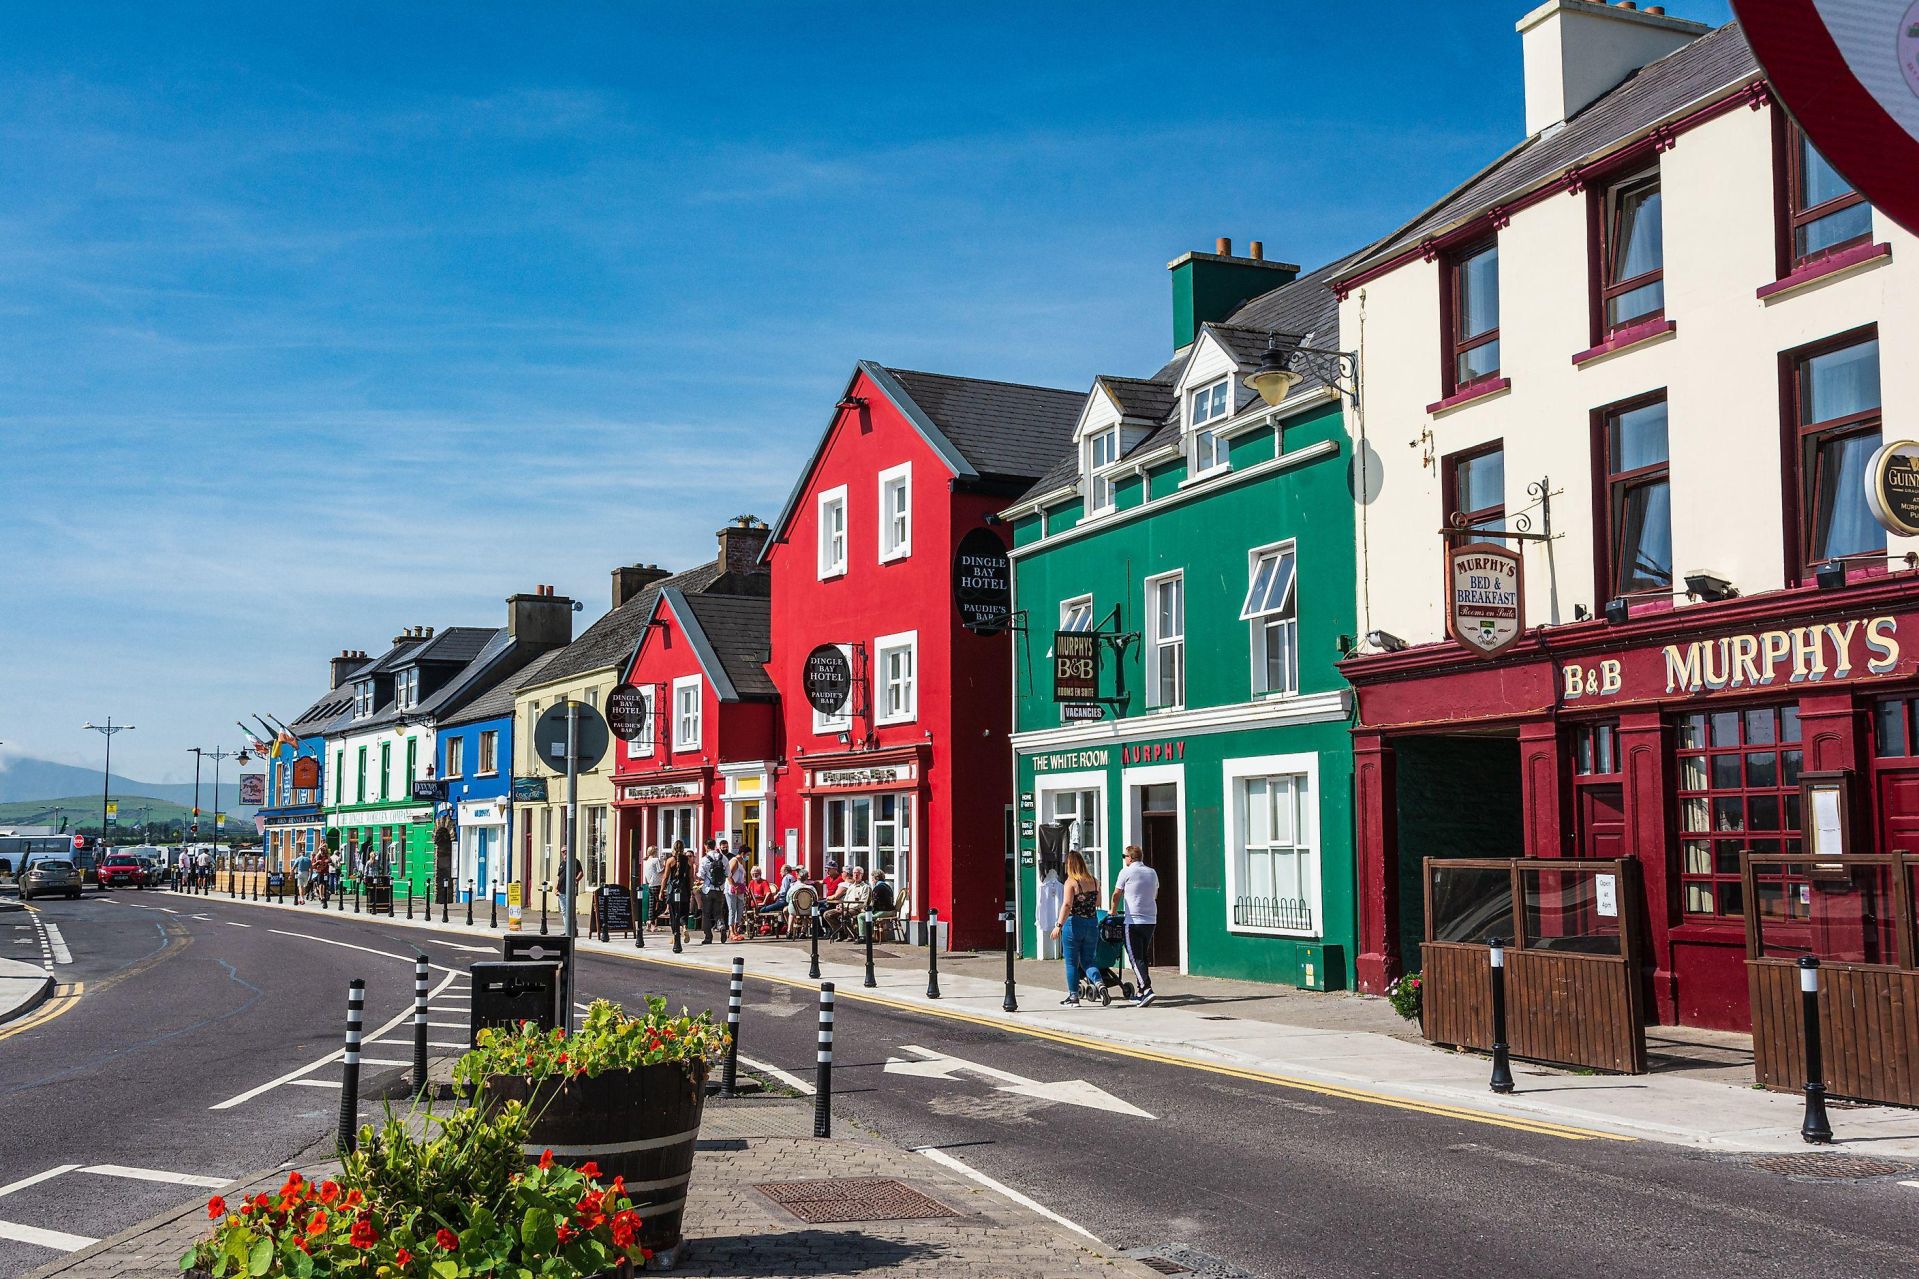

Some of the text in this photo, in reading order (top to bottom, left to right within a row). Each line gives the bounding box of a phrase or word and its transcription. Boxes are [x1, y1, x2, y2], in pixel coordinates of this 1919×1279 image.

[962, 556, 1006, 568] DINGLE
[1456, 558, 1516, 577] MURPHY'S
[974, 568, 995, 577] BAY
[962, 577, 1007, 590] HOTEL
[1470, 576, 1501, 590] BED &
[1457, 590, 1516, 605] BREAKFAST
[964, 604, 1006, 614] PAUDIE'S
[1460, 606, 1484, 617] Rooms
[1496, 607, 1515, 618] Suite
[976, 613, 994, 621] BAR
[1057, 636, 1093, 657] MURPHYS
[810, 657, 843, 666] DINGLE
[1563, 616, 1900, 699] B&B MURPHY'S
[1057, 658, 1094, 679] B&B
[810, 672, 844, 682] HOTEL
[1057, 687, 1074, 697] ROOMS
[1074, 687, 1081, 697] EN
[1065, 707, 1102, 718] VACANCIES
[1122, 741, 1185, 764] MURPHY
[1032, 750, 1108, 771] THE WHITE ROOM
